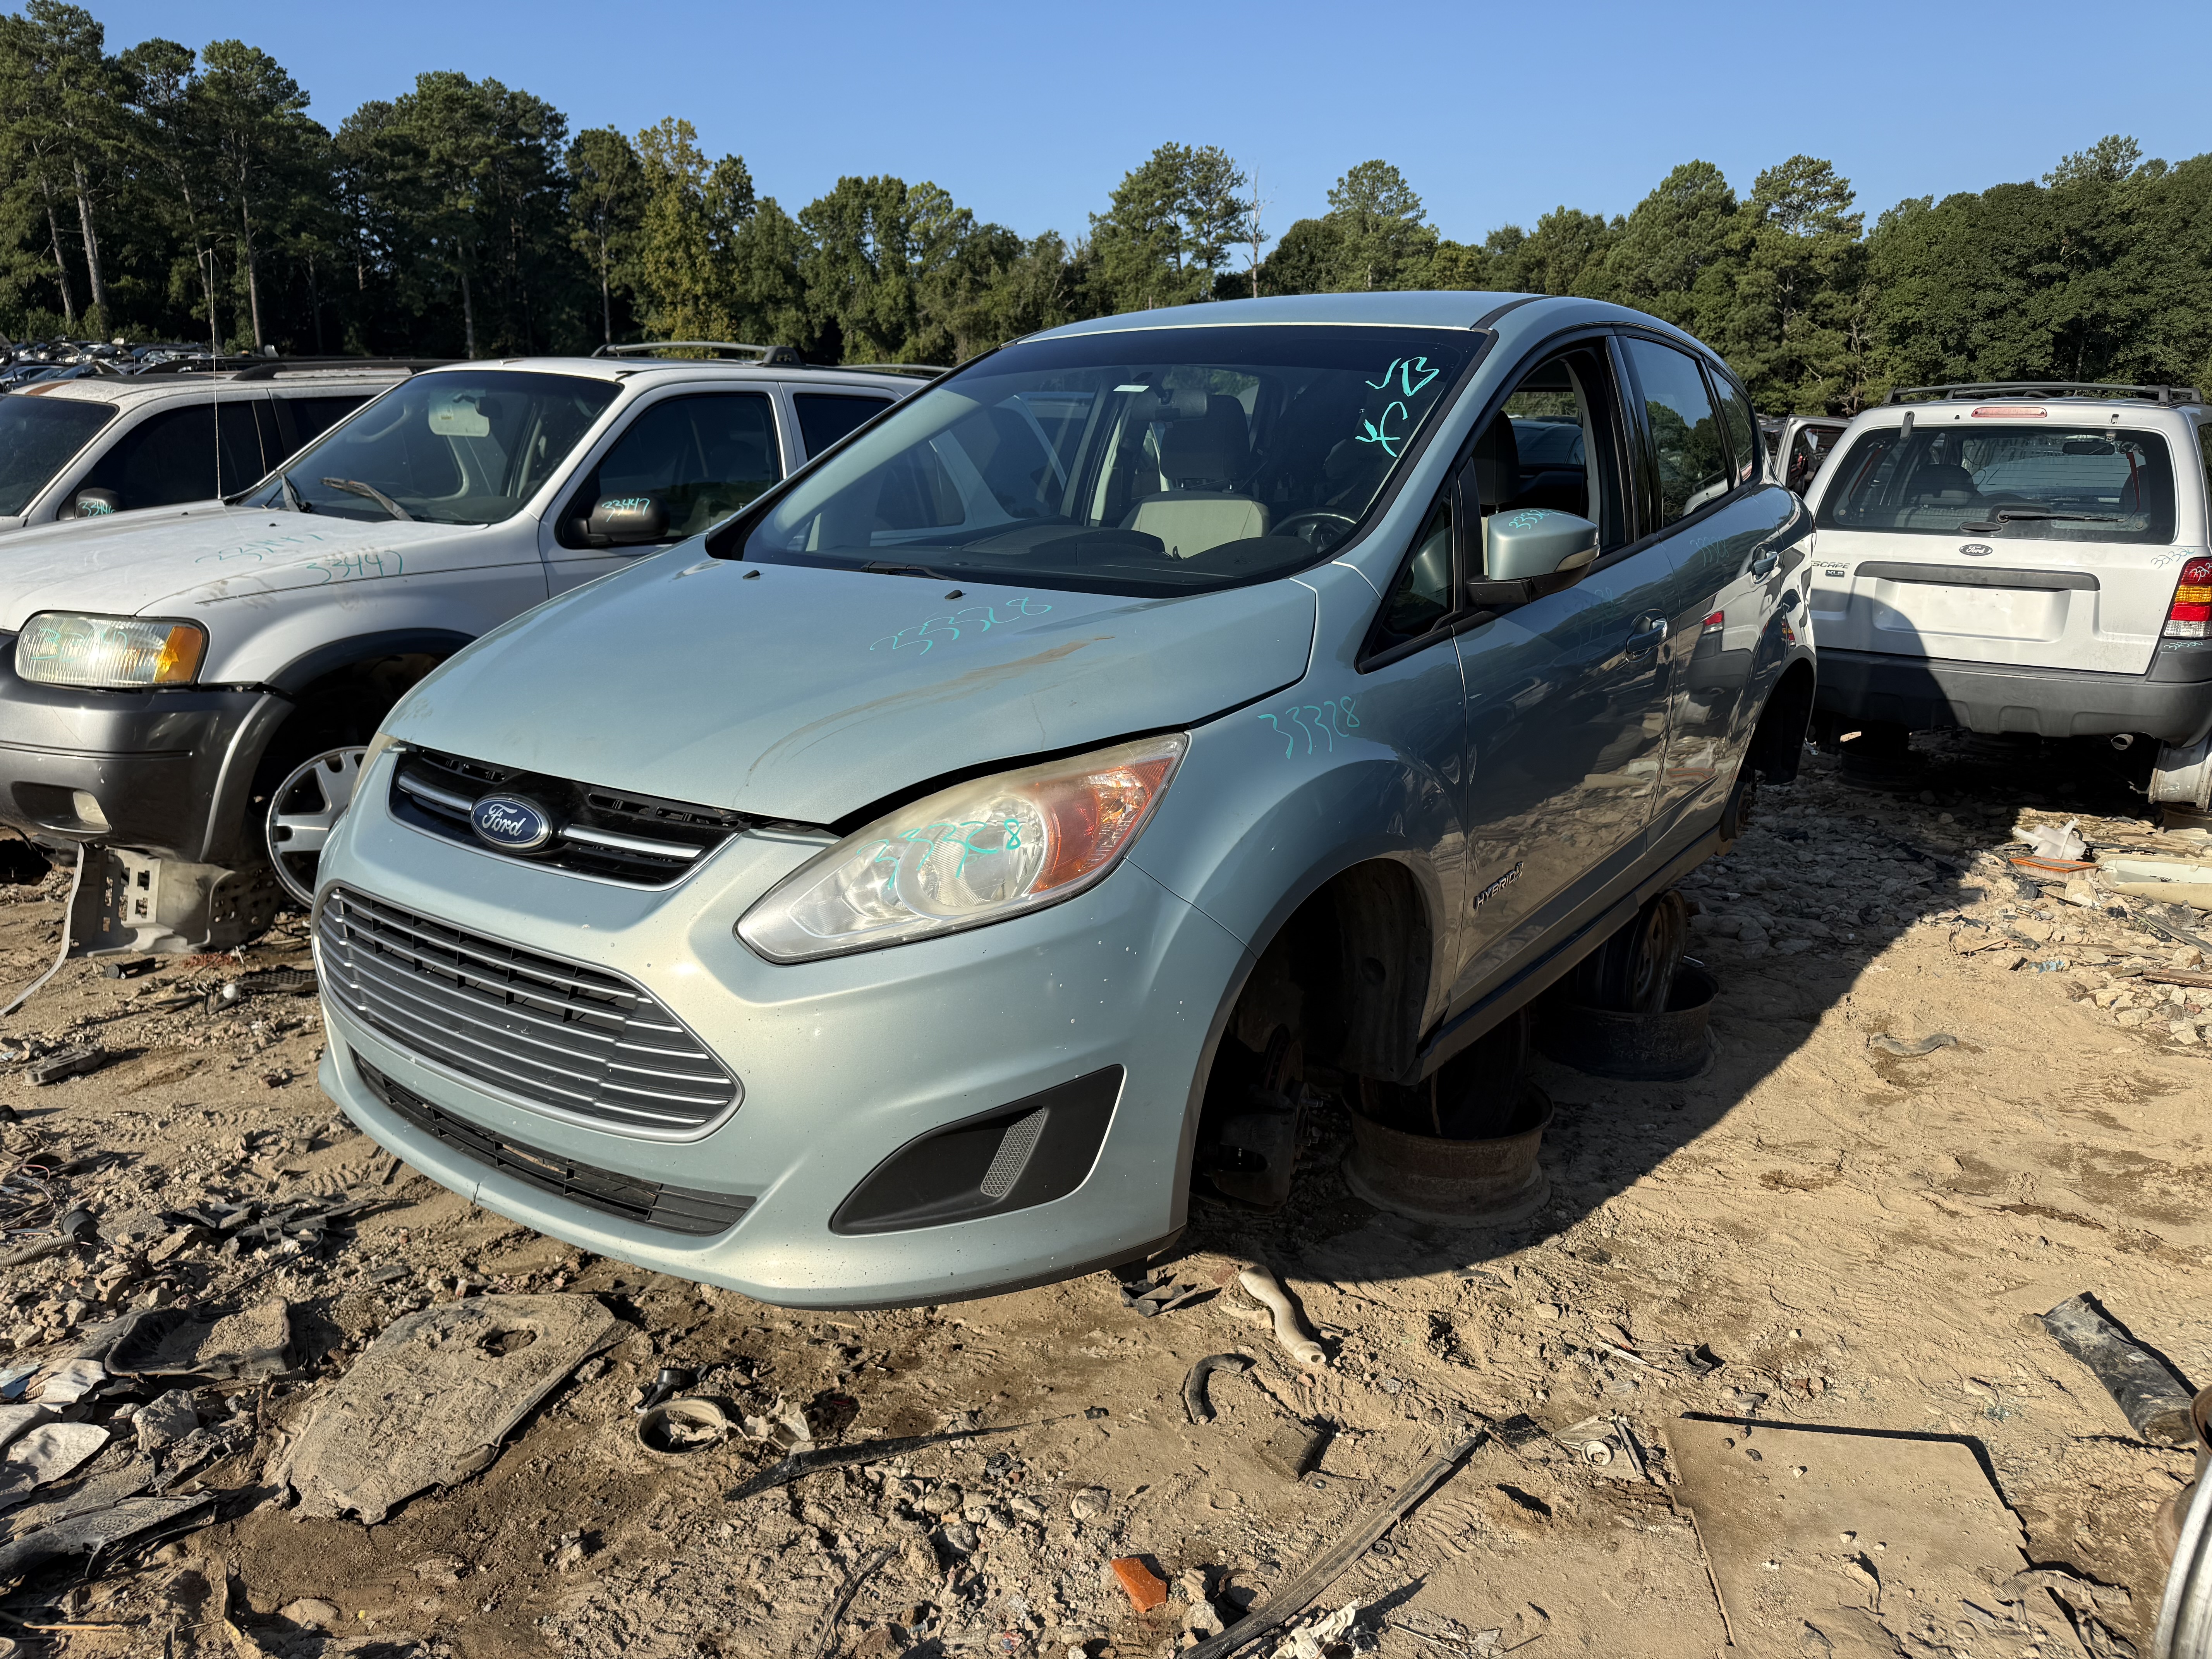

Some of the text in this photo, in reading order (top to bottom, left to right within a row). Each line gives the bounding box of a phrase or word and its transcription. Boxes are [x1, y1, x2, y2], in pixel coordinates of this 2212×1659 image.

[602, 498, 650, 522] 33447
[294, 550, 403, 584] 33447
[1811, 560, 1851, 568] SCAPE
[870, 597, 1052, 655] 33328
[1257, 696, 1360, 759] 33328
[482, 804, 526, 836] Ford
[857, 818, 1022, 889] 33328
[1473, 870, 1516, 910] HYBRID
